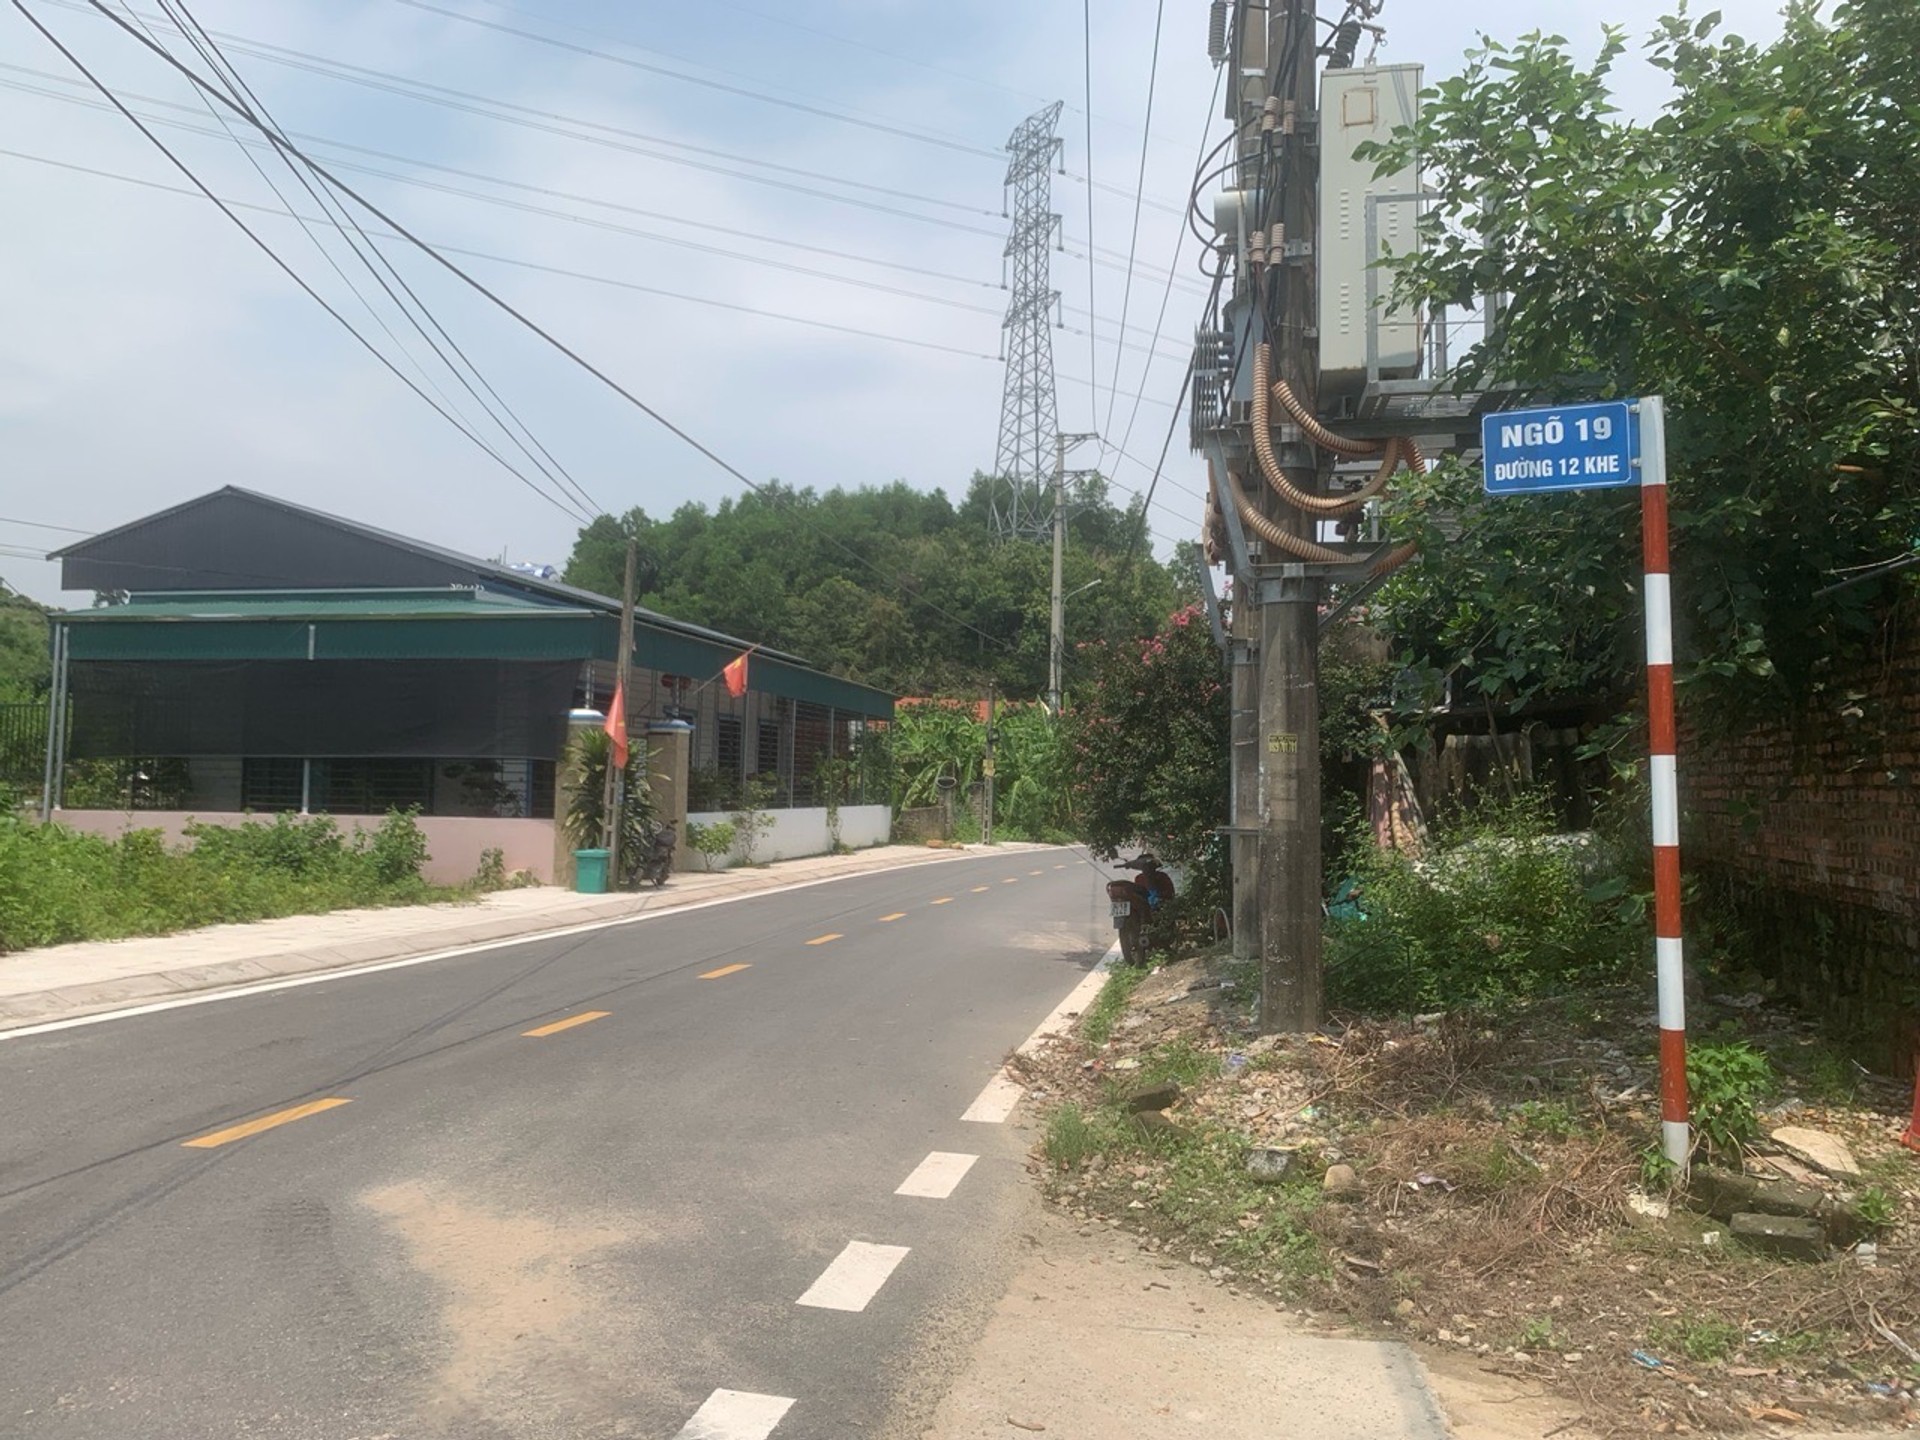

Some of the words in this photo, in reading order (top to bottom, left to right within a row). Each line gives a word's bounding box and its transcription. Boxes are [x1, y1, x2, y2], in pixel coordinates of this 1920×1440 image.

[1501, 416, 1564, 448] NGÕ
[1575, 416, 1612, 441] 19
[1495, 457, 1553, 481] ĐƯỜNG
[1558, 458, 1579, 475] 12
[1584, 455, 1620, 474] KHE
